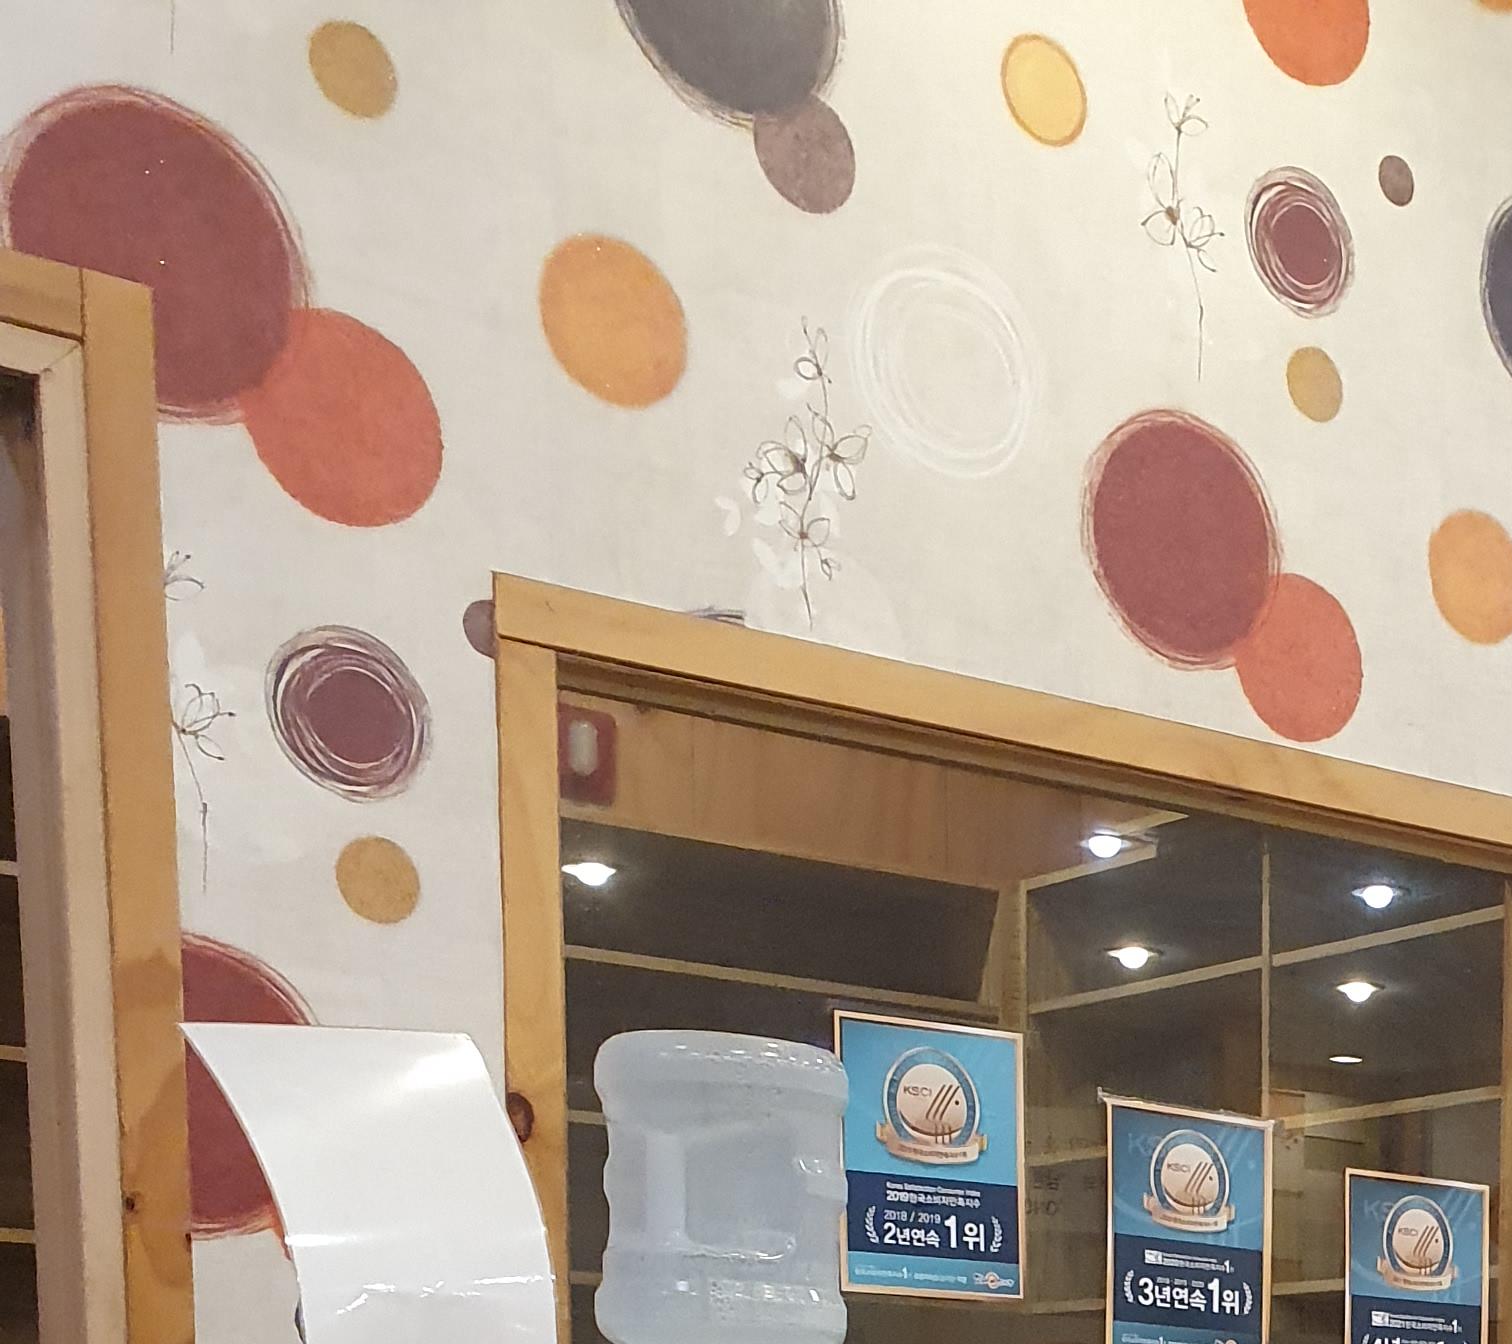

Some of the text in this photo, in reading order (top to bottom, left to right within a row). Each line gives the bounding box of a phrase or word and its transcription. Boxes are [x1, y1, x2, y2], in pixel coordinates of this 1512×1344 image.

[903, 1085, 932, 1097] KSCI
[883, 1215, 986, 1252] 2년연속 1위
